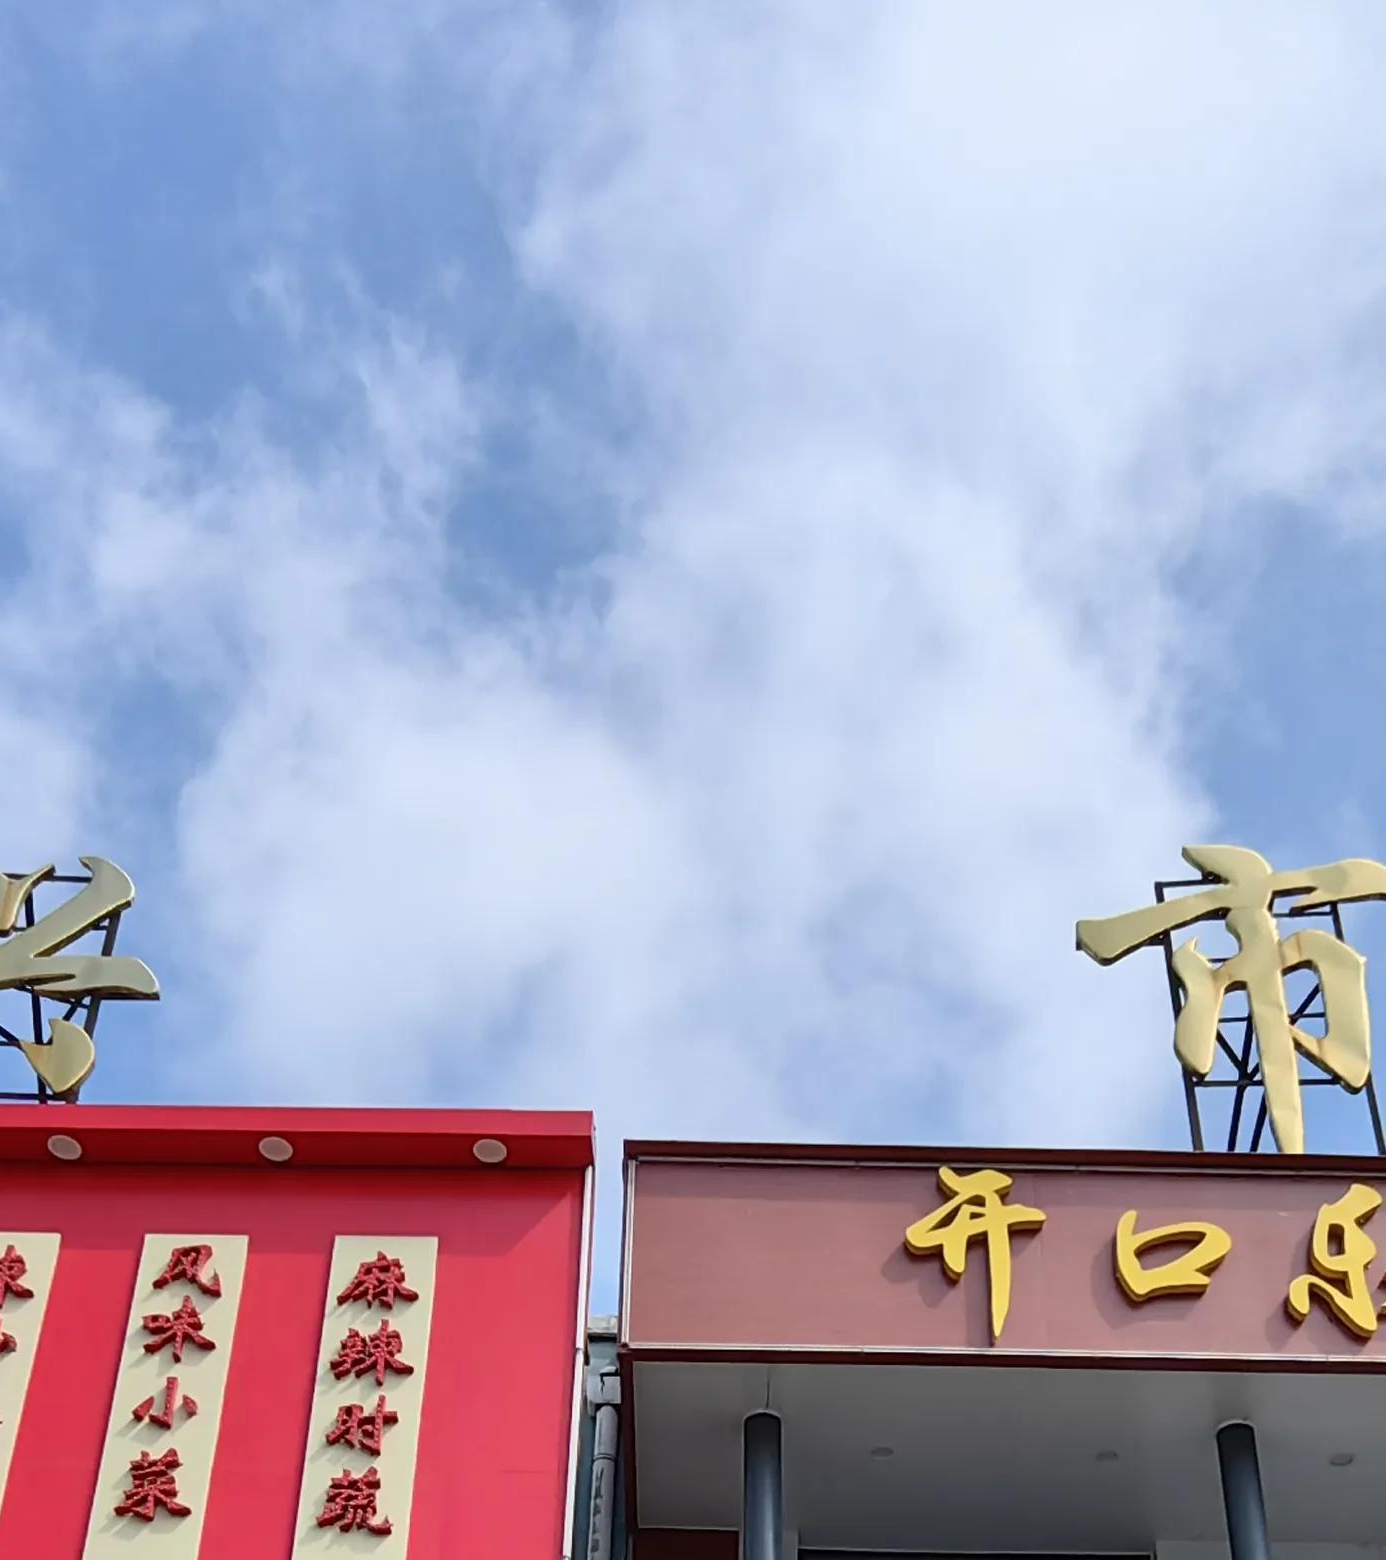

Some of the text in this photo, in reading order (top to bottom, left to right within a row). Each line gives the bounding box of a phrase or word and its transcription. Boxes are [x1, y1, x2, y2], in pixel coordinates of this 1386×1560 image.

[114, 1244, 222, 1522] 风味小菜
[317, 1251, 419, 1536] 麻辣时蔬
